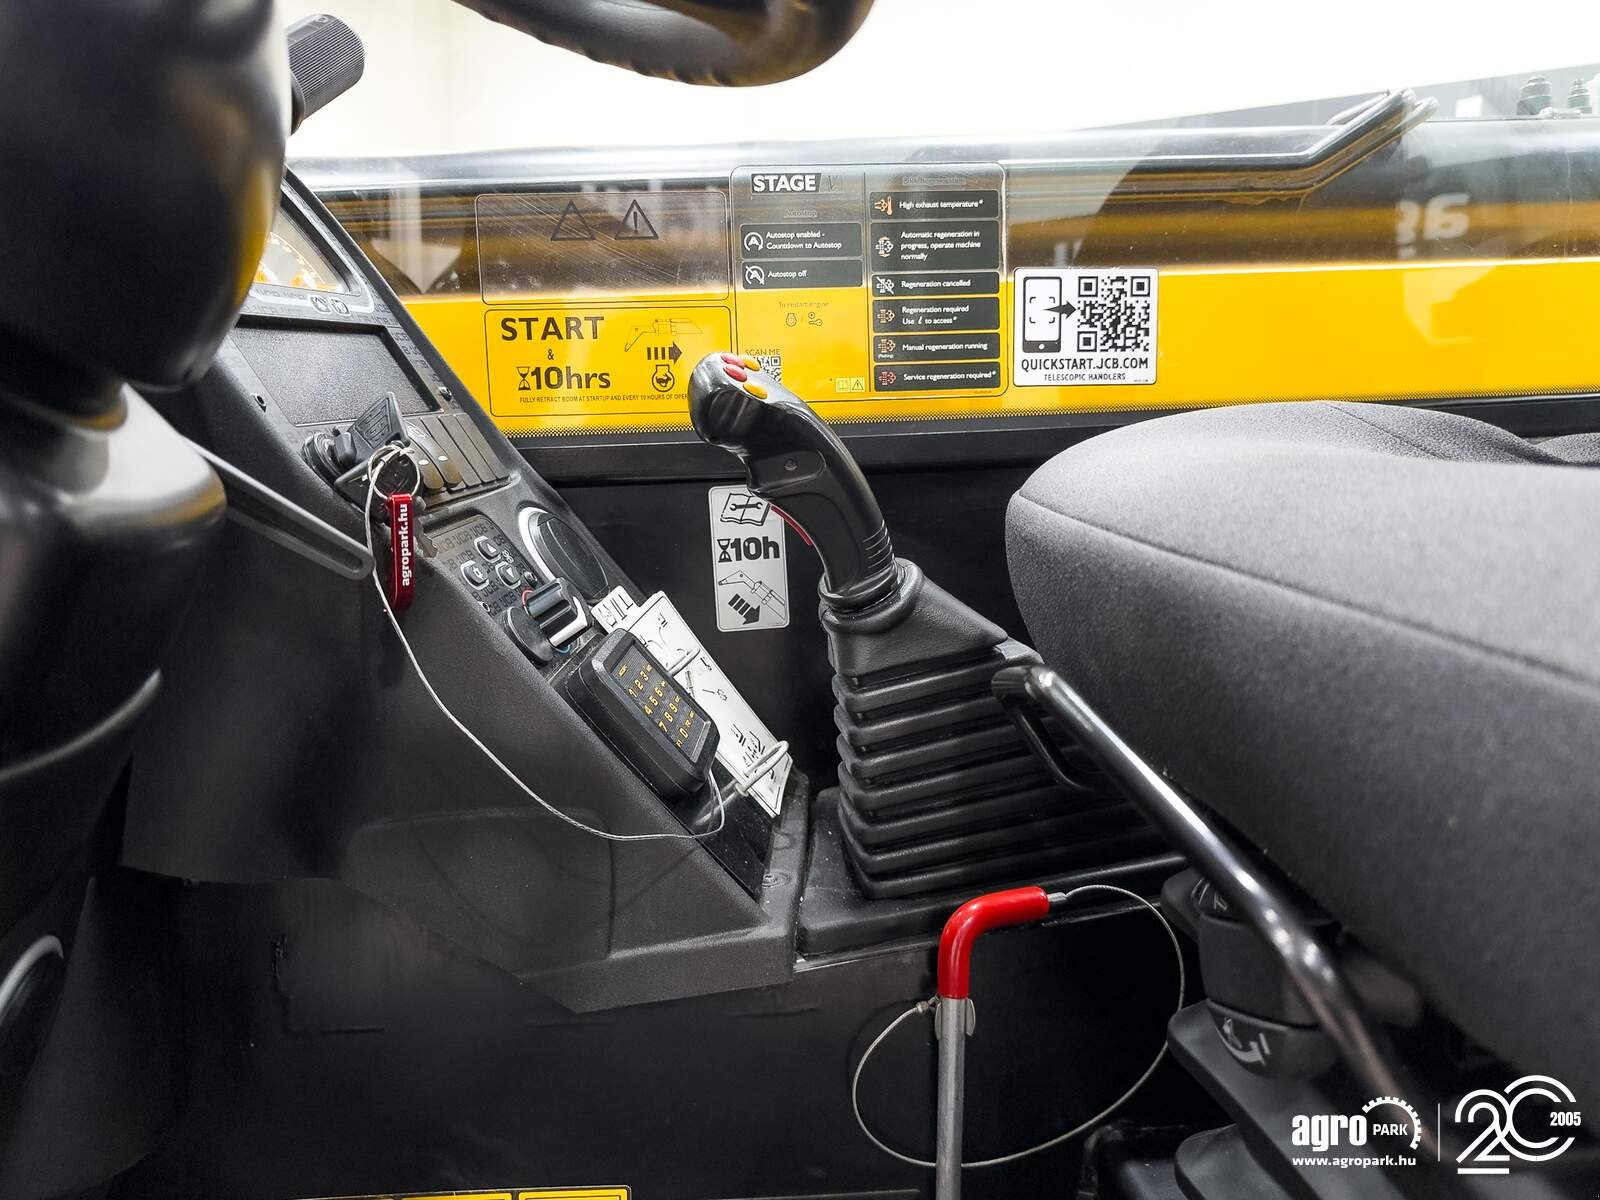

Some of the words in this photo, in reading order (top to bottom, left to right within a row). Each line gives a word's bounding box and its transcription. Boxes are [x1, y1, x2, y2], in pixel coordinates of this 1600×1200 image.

[752, 174, 816, 192] STAGE
[899, 202, 914, 210] High
[766, 232, 796, 240] Autostop
[796, 230, 821, 238] enabled
[934, 231, 973, 240] regeneration
[974, 230, 980, 238] in
[766, 242, 804, 250] Countdown
[812, 242, 842, 250] Autostop
[900, 243, 929, 251] progress,
[930, 242, 955, 250] operate
[955, 240, 981, 248] machine
[900, 252, 928, 261] normally
[768, 270, 797, 278] Autostop
[901, 280, 942, 290] Regeneration
[942, 279, 971, 288] cancelled
[902, 306, 942, 315] Regeneration
[942, 304, 970, 314] required
[500, 316, 605, 341] START
[744, 348, 767, 356] SCAN
[768, 348, 781, 356] ME
[902, 343, 924, 351] Manual
[925, 342, 964, 352] regeneration
[964, 342, 988, 350] running
[547, 348, 554, 360] &
[1022, 357, 1149, 372] QUICKSTART.JCB.COM
[530, 366, 611, 390] 10hrs
[904, 374, 926, 382] Service
[926, 372, 966, 382] regeneration
[1044, 373, 1086, 381] TELESCOPIC
[1088, 372, 1126, 380] HANDLERS
[398, 503, 412, 587] agropark.hu
[730, 536, 780, 562] 10h
[628, 688, 638, 698] 1
[634, 679, 644, 690] 2
[640, 670, 648, 681] 3
[644, 704, 653, 715] 4
[649, 696, 658, 706] 5
[654, 687, 663, 697] 6
[668, 702, 678, 713] 9
[664, 712, 674, 722] 8
[658, 720, 668, 732] 7
[679, 728, 688, 738] 0
